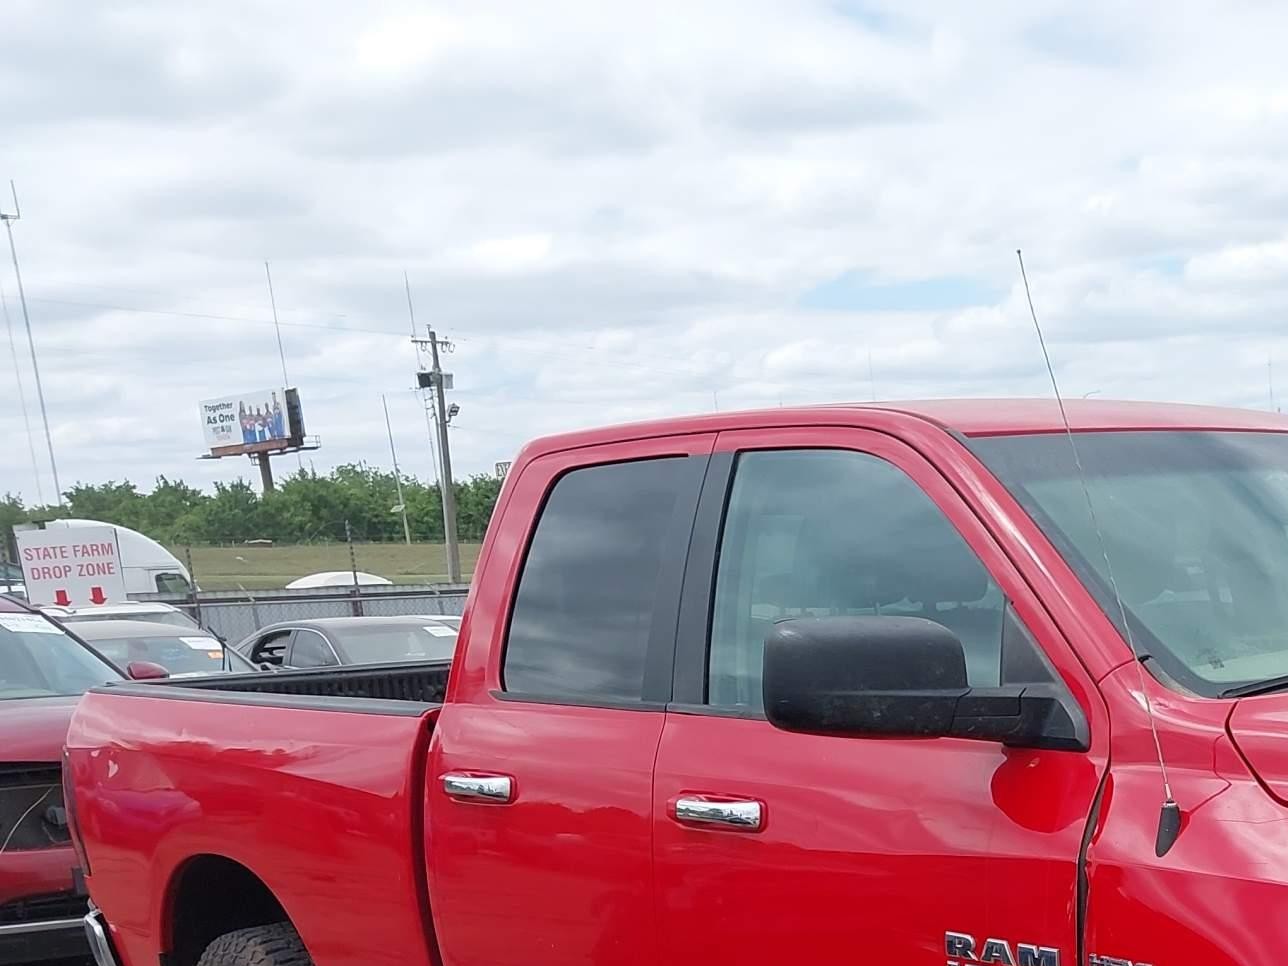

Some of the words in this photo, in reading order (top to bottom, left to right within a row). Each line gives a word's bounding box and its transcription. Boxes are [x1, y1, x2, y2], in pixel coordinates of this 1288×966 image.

[204, 402, 233, 413] Together
[207, 415, 217, 424] As
[218, 413, 235, 423] One
[23, 545, 68, 561] STATE
[72, 543, 114, 558] FARM
[30, 565, 72, 580] DROP
[76, 562, 115, 577] ZONE
